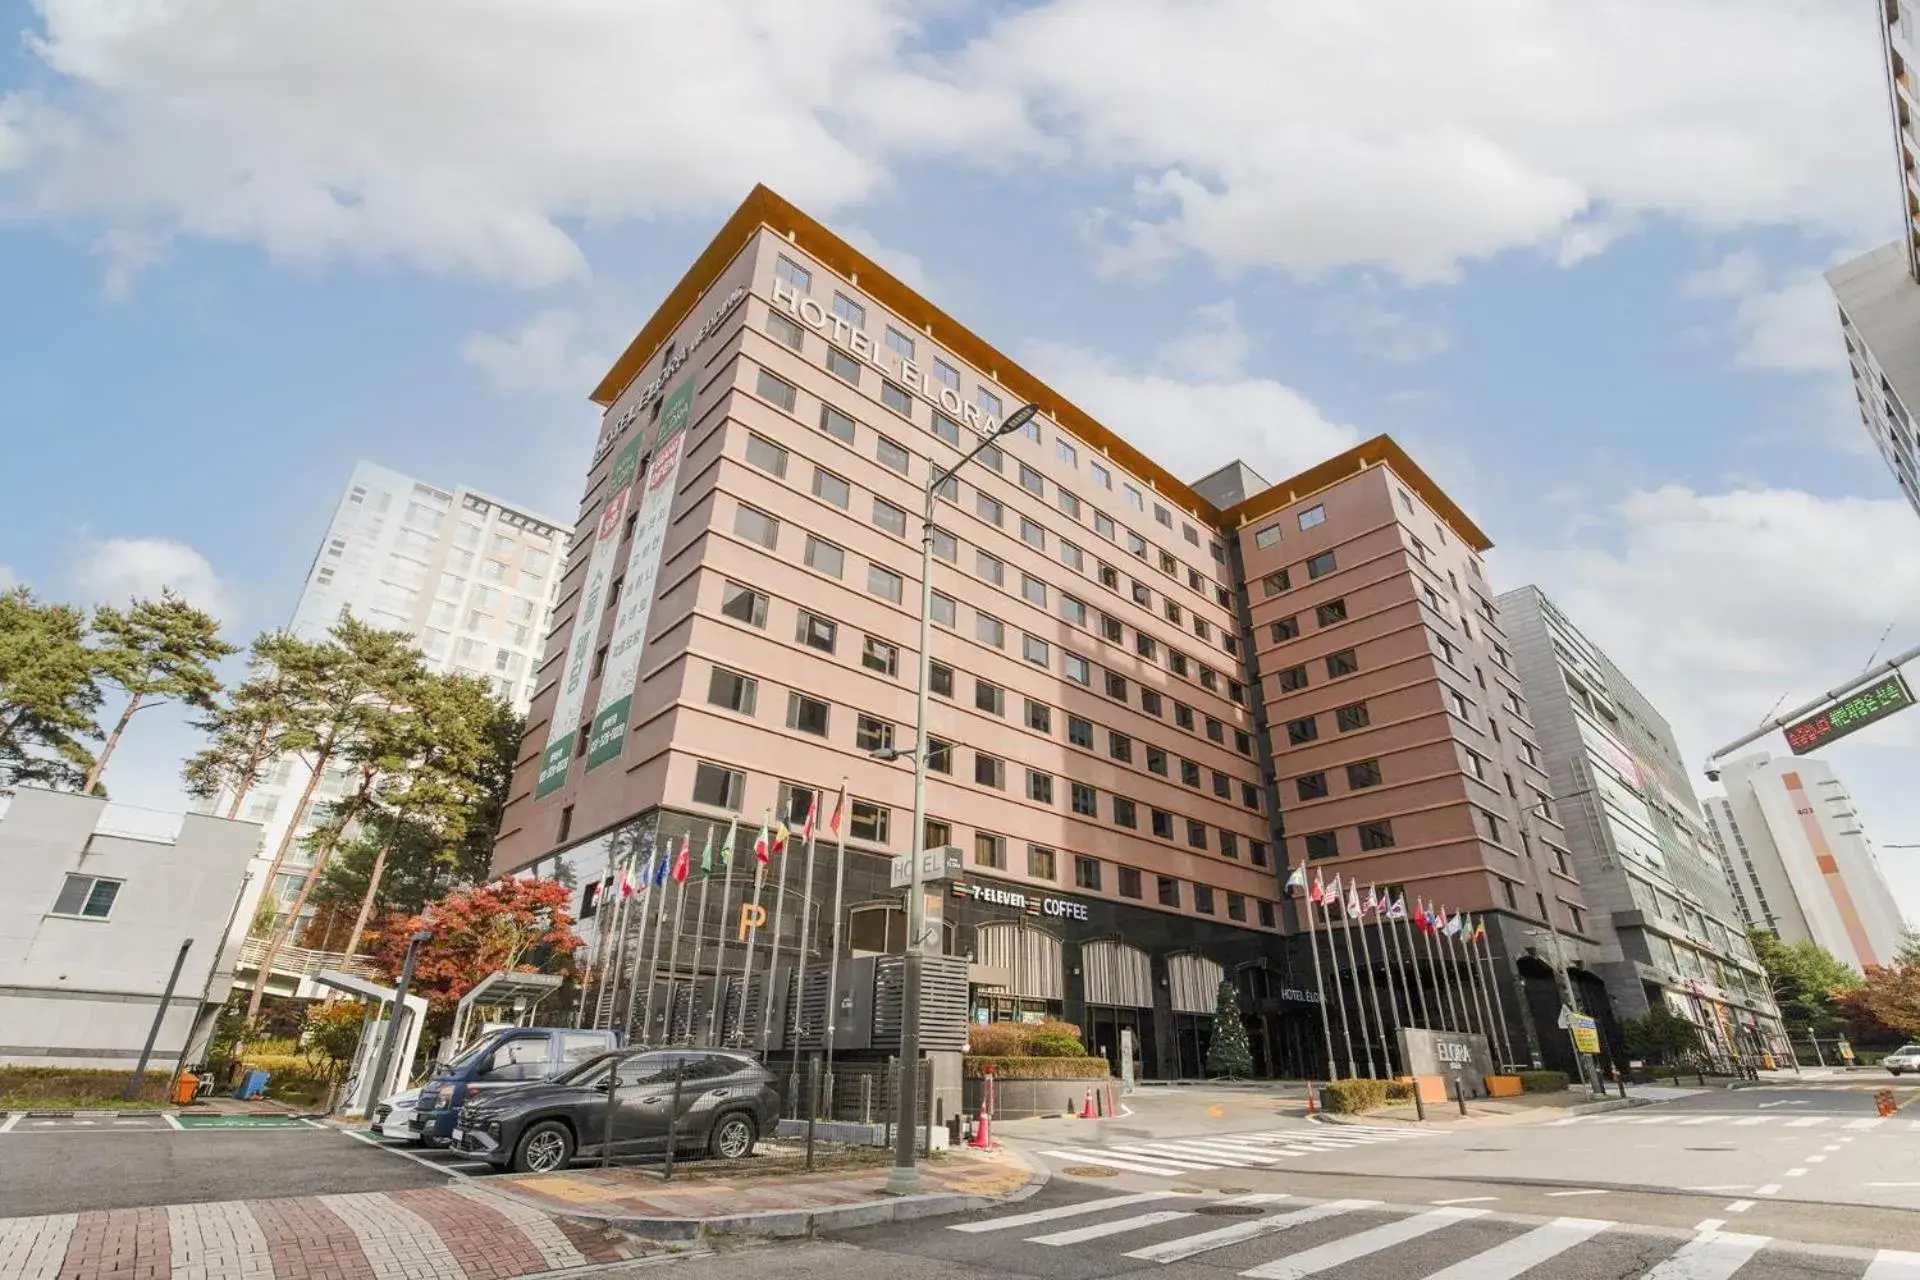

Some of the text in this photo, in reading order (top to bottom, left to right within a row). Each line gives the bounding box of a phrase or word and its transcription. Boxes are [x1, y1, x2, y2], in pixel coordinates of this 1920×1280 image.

[772, 277, 890, 375] HOTEL
[894, 854, 943, 879] HOEL
[738, 902, 768, 941] P
[1044, 898, 1089, 921] COFFEE
[1281, 989, 1305, 1002] HOTEL
